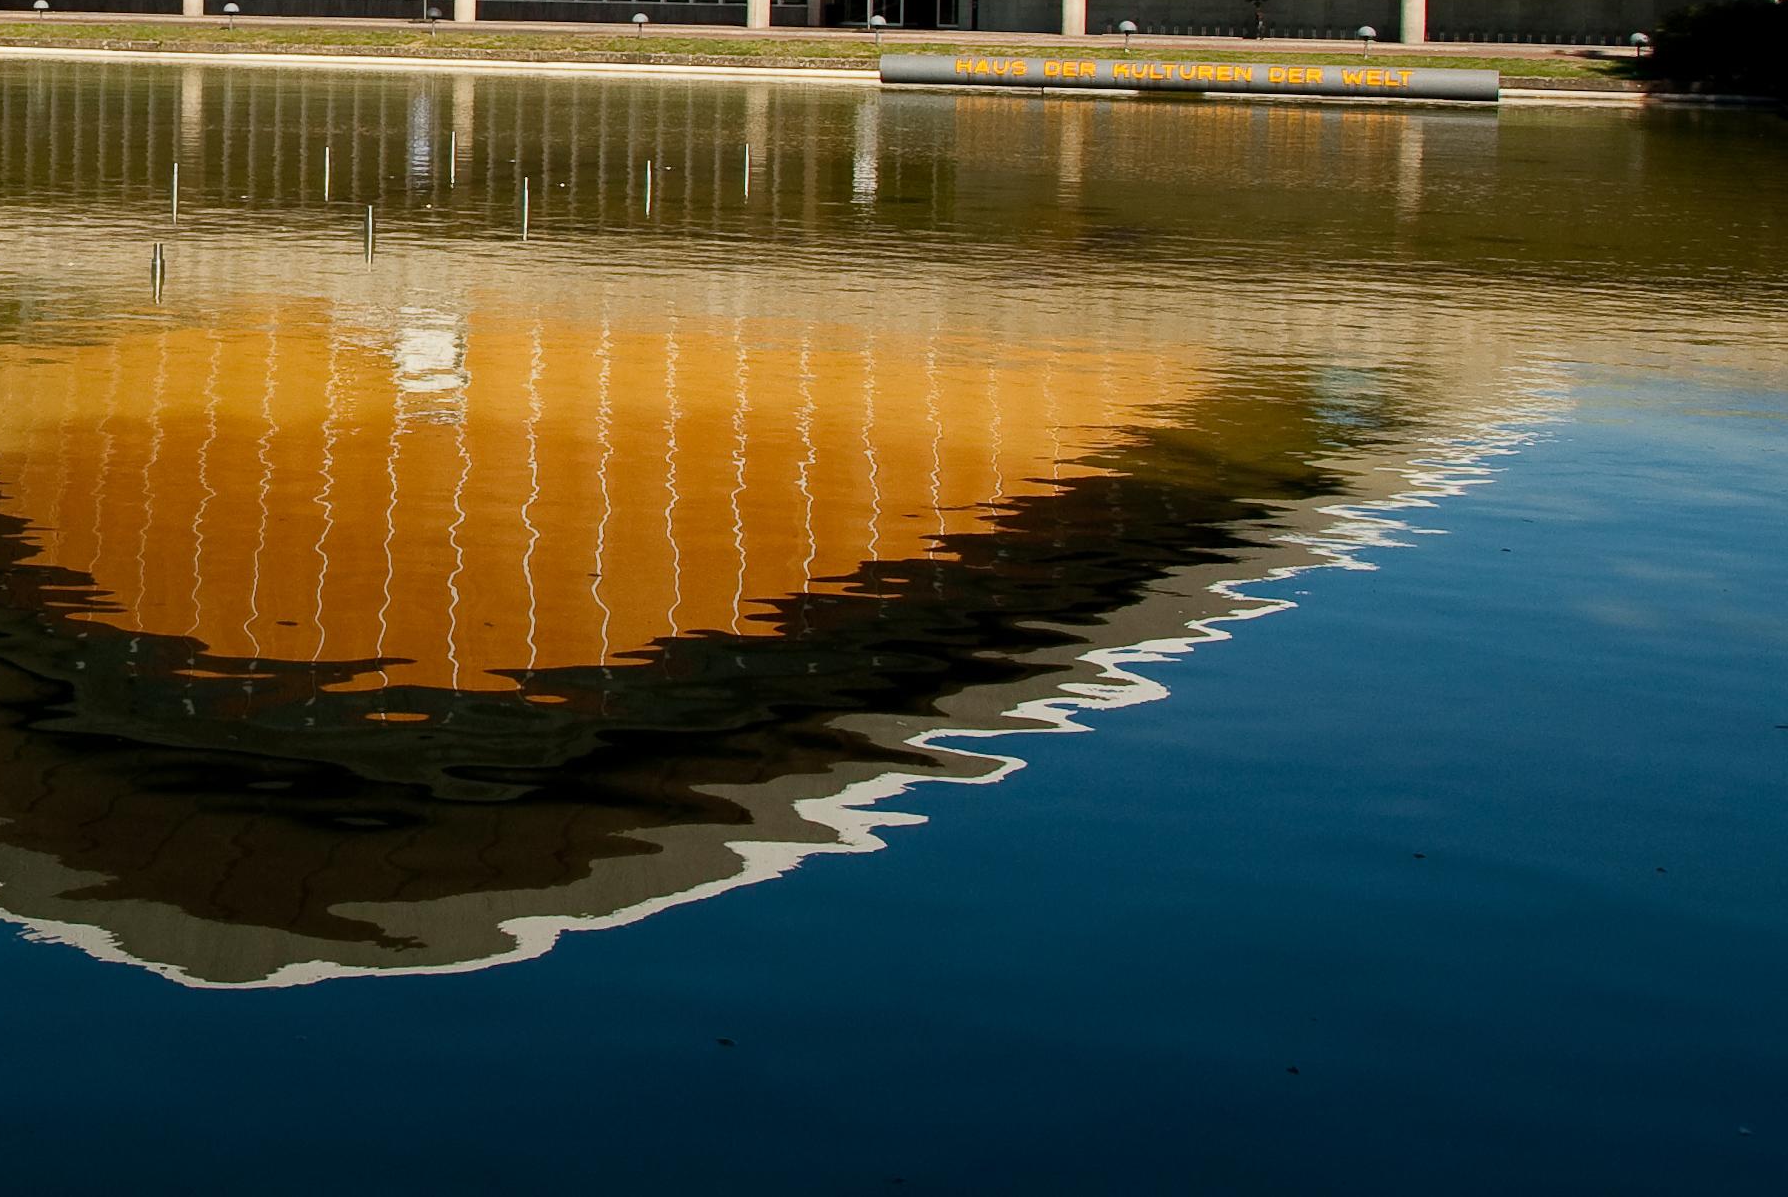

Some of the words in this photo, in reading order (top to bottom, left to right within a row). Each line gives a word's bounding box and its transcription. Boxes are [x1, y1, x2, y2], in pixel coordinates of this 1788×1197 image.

[955, 58, 1028, 76] HAUS
[1044, 60, 1097, 78] DER
[1113, 63, 1253, 82] KULTUREN
[1268, 66, 1324, 84] DER
[1341, 68, 1414, 88] WELT
